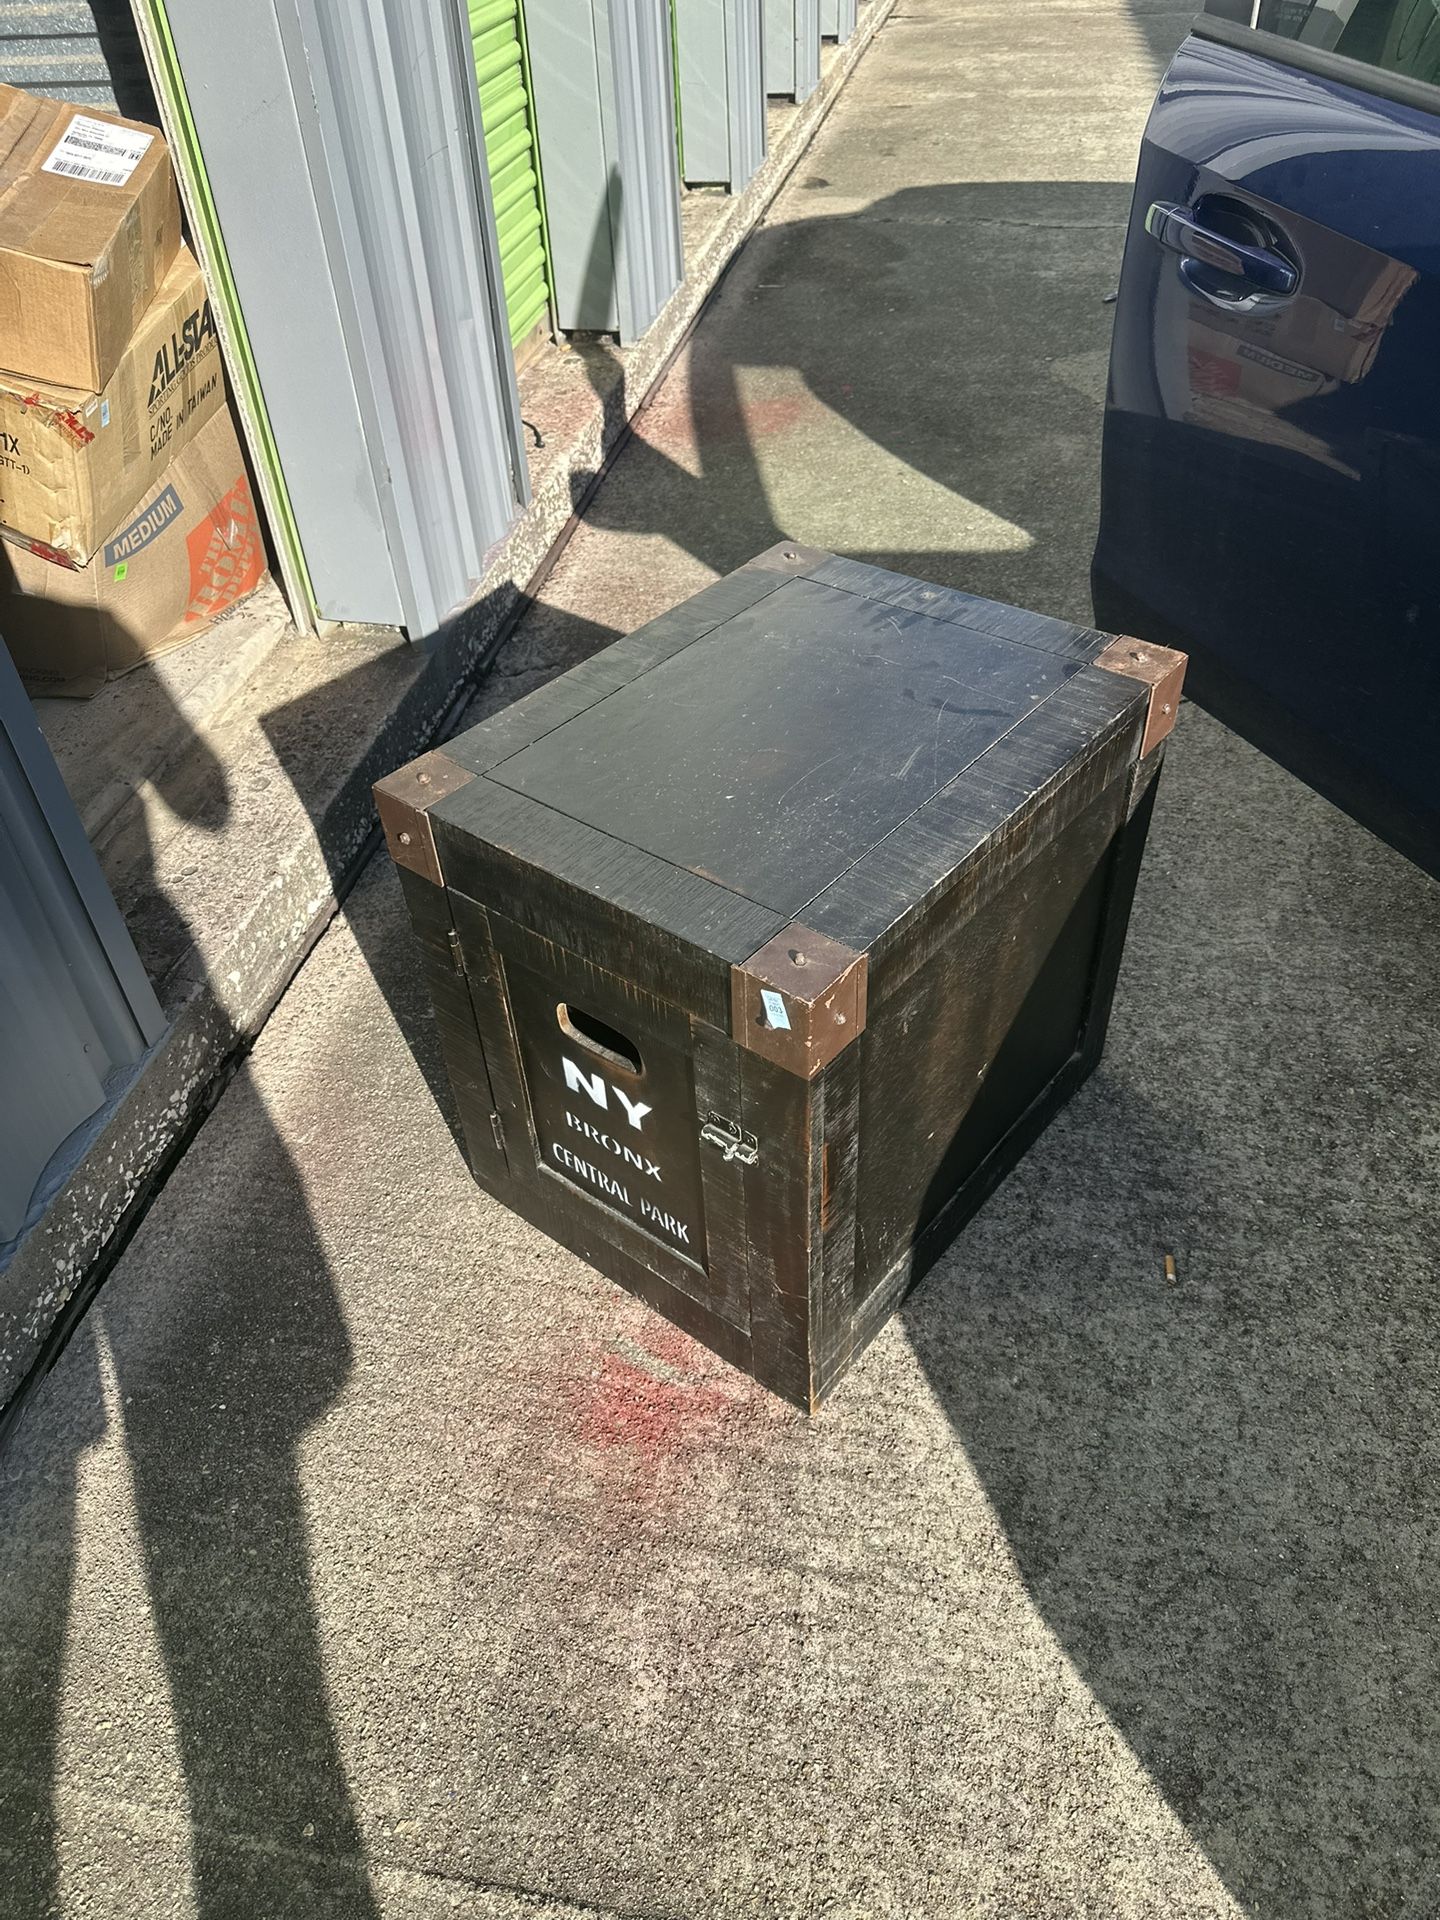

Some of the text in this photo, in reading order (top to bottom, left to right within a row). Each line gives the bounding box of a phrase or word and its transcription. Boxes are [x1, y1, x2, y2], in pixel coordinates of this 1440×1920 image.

[147, 297, 218, 408] ALL-STA
[150, 372, 218, 462] MADE IN TAIWAN
[113, 491, 178, 561] MEDIUM
[562, 1056, 652, 1132] NY
[565, 1110, 662, 1182] BRONX
[552, 1142, 690, 1245] CENTRAL PARK
